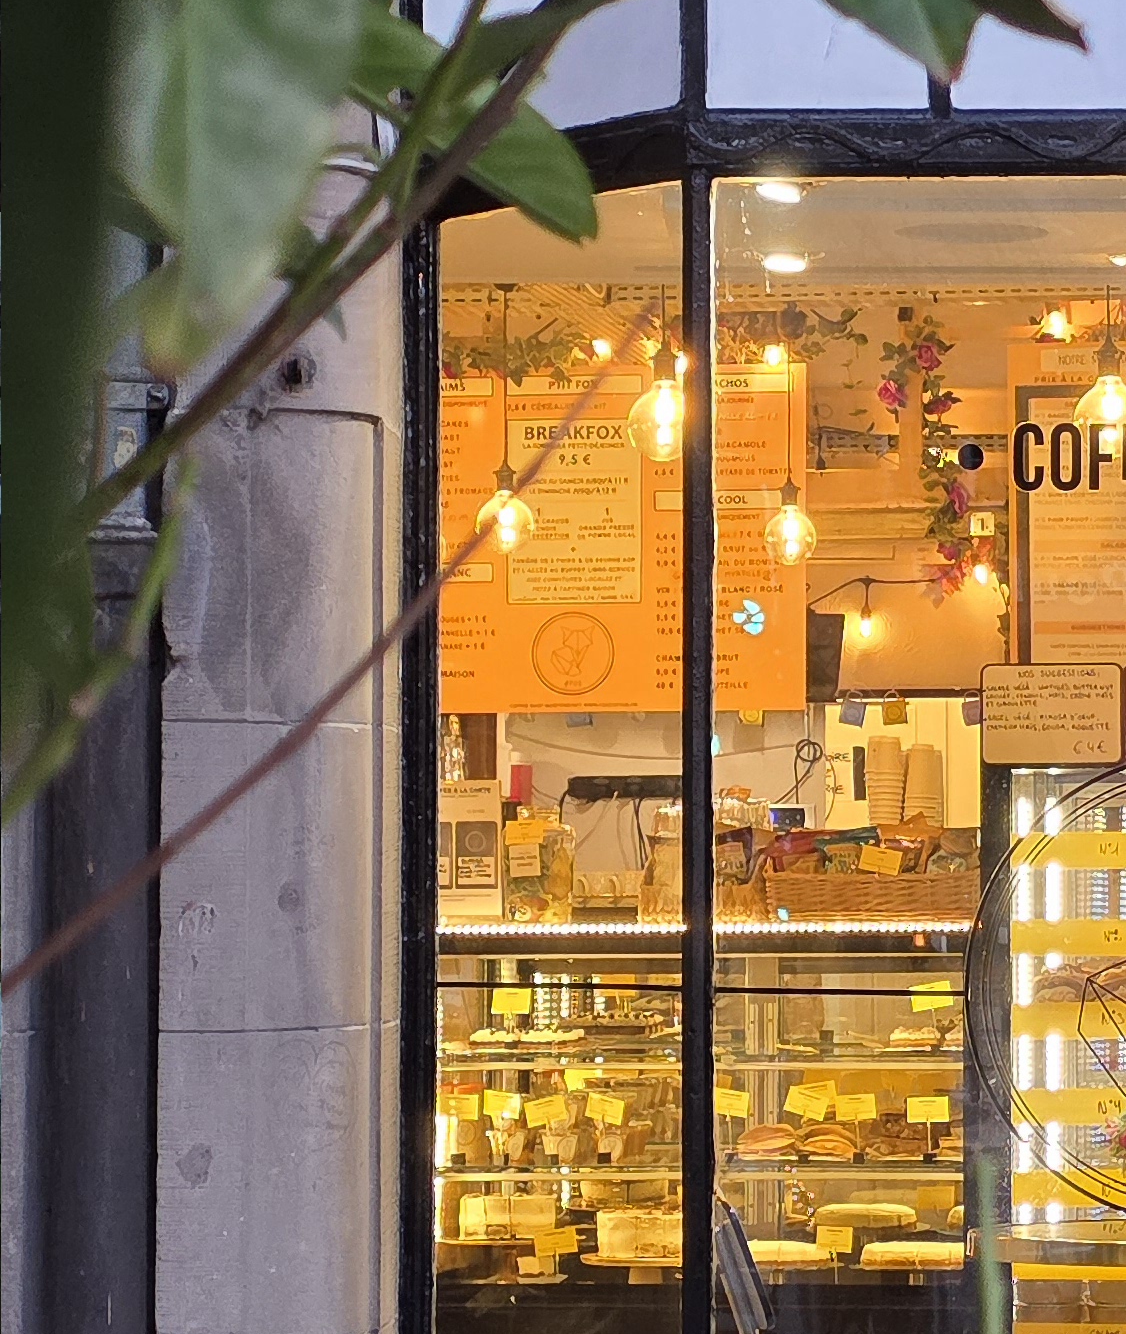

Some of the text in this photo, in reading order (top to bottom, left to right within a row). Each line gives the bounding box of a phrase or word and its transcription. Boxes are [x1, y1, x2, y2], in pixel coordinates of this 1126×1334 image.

[523, 424, 624, 441] BREAKFOX
[557, 453, 592, 467] 9,5 €
[717, 494, 749, 505] COOL
[721, 586, 751, 594] BLANC
[440, 669, 476, 679] MAISON
[1097, 1098, 1123, 1115] N°4
